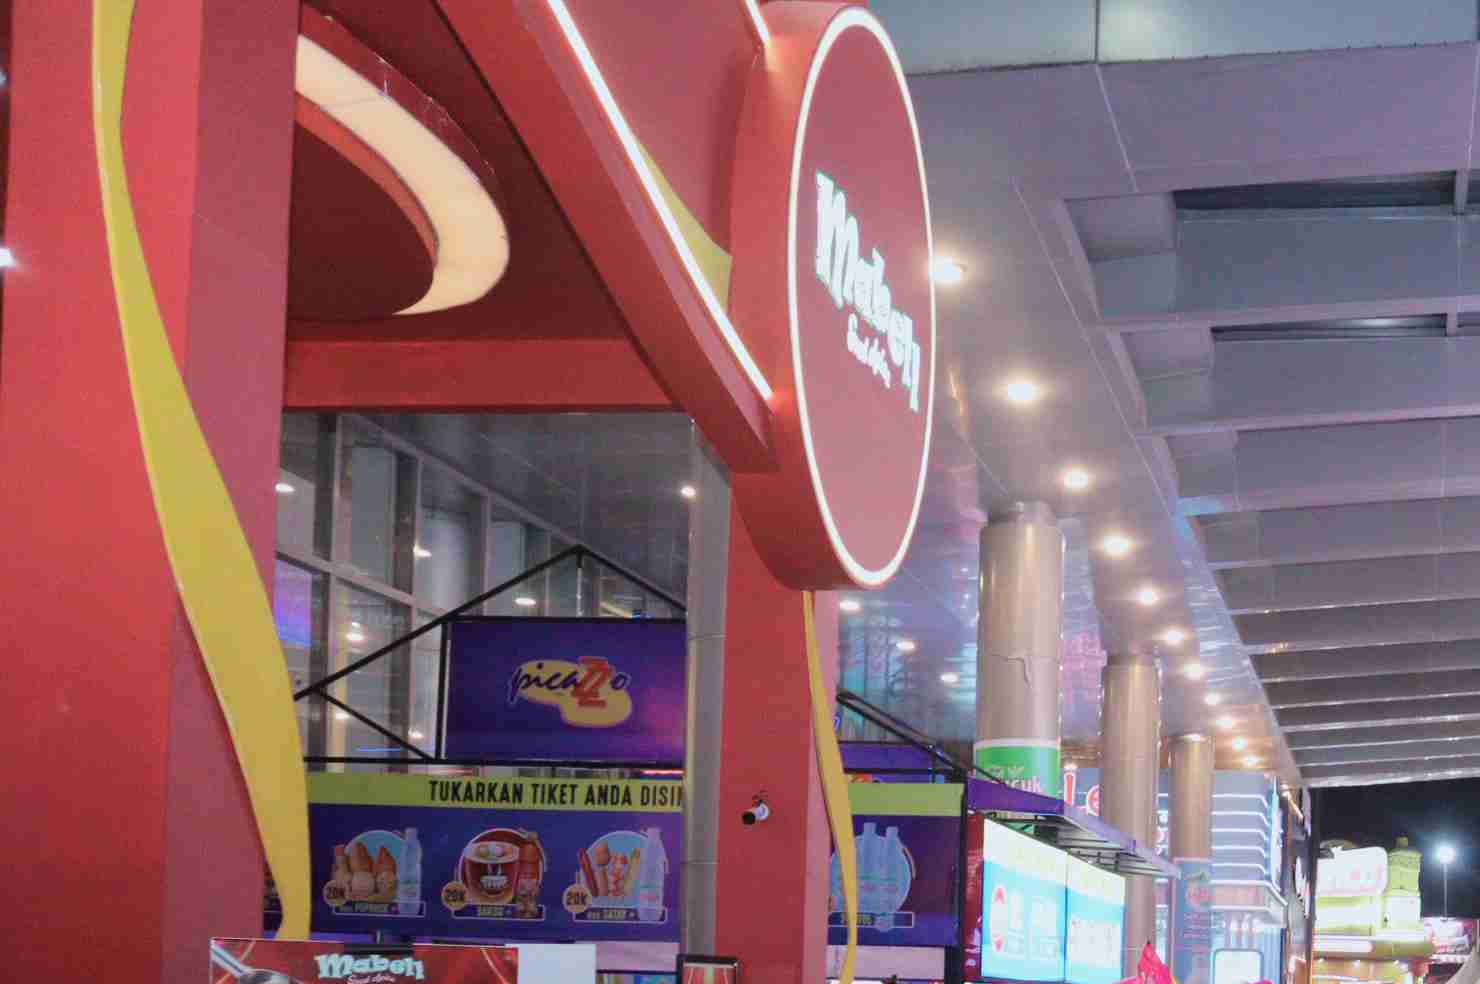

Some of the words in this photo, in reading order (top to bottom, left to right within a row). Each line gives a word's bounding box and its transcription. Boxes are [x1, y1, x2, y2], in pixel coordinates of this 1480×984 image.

[428, 780, 524, 802] TUKARKAN
[530, 783, 578, 803] TIKET
[584, 785, 632, 806] ANDA
